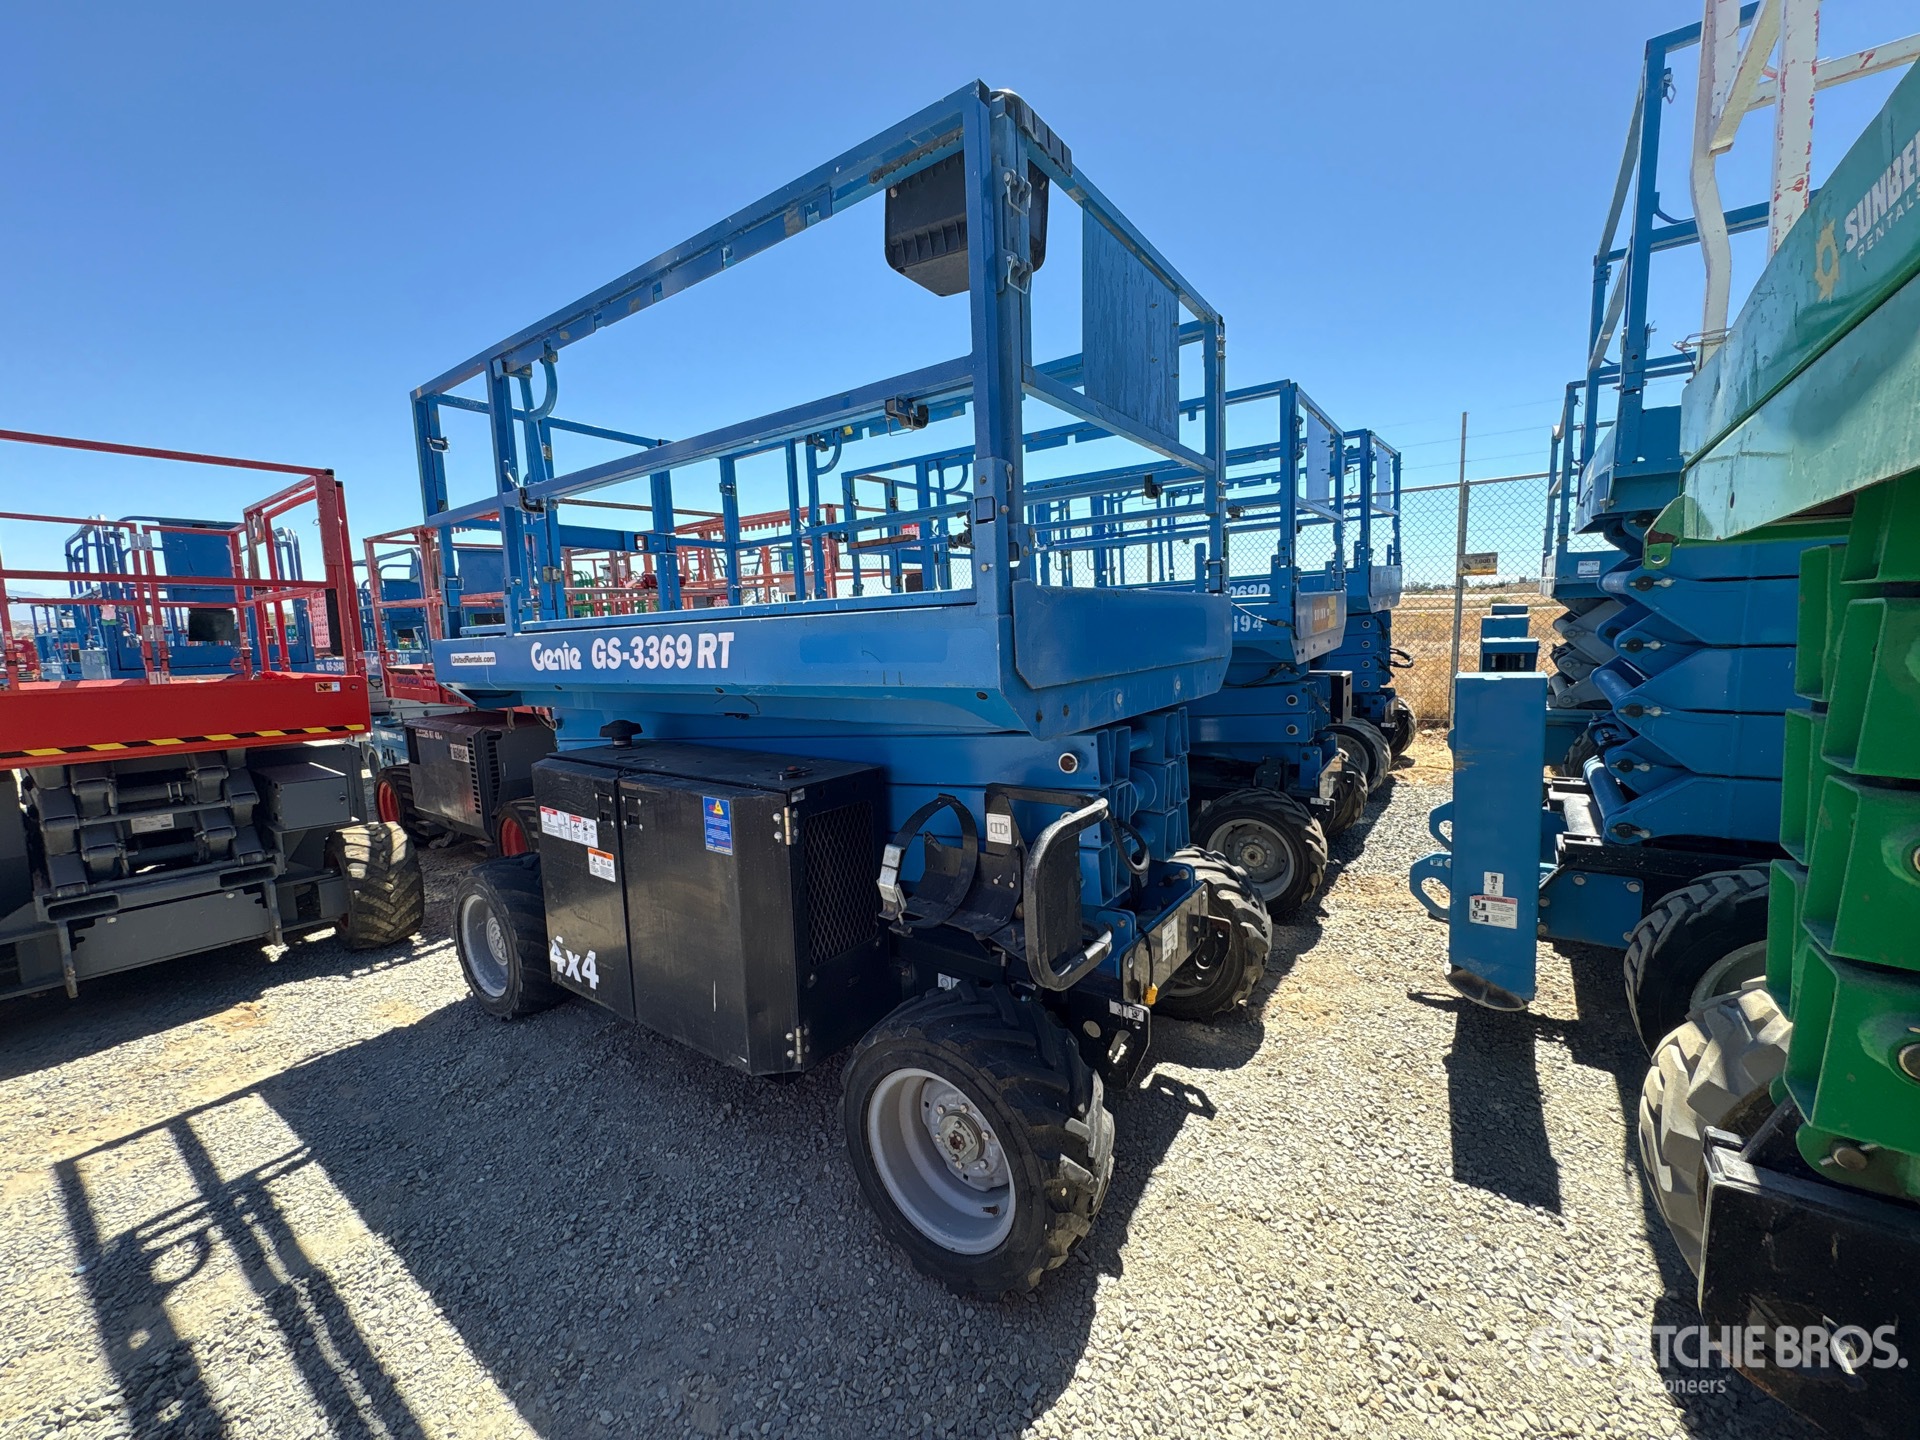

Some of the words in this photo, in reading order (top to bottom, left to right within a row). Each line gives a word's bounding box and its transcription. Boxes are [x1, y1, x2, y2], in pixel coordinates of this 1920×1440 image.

[451, 655, 496, 664] UnitedRentals.com
[530, 641, 582, 671] Genie
[591, 633, 692, 670] GS-3369
[697, 632, 735, 669] RT
